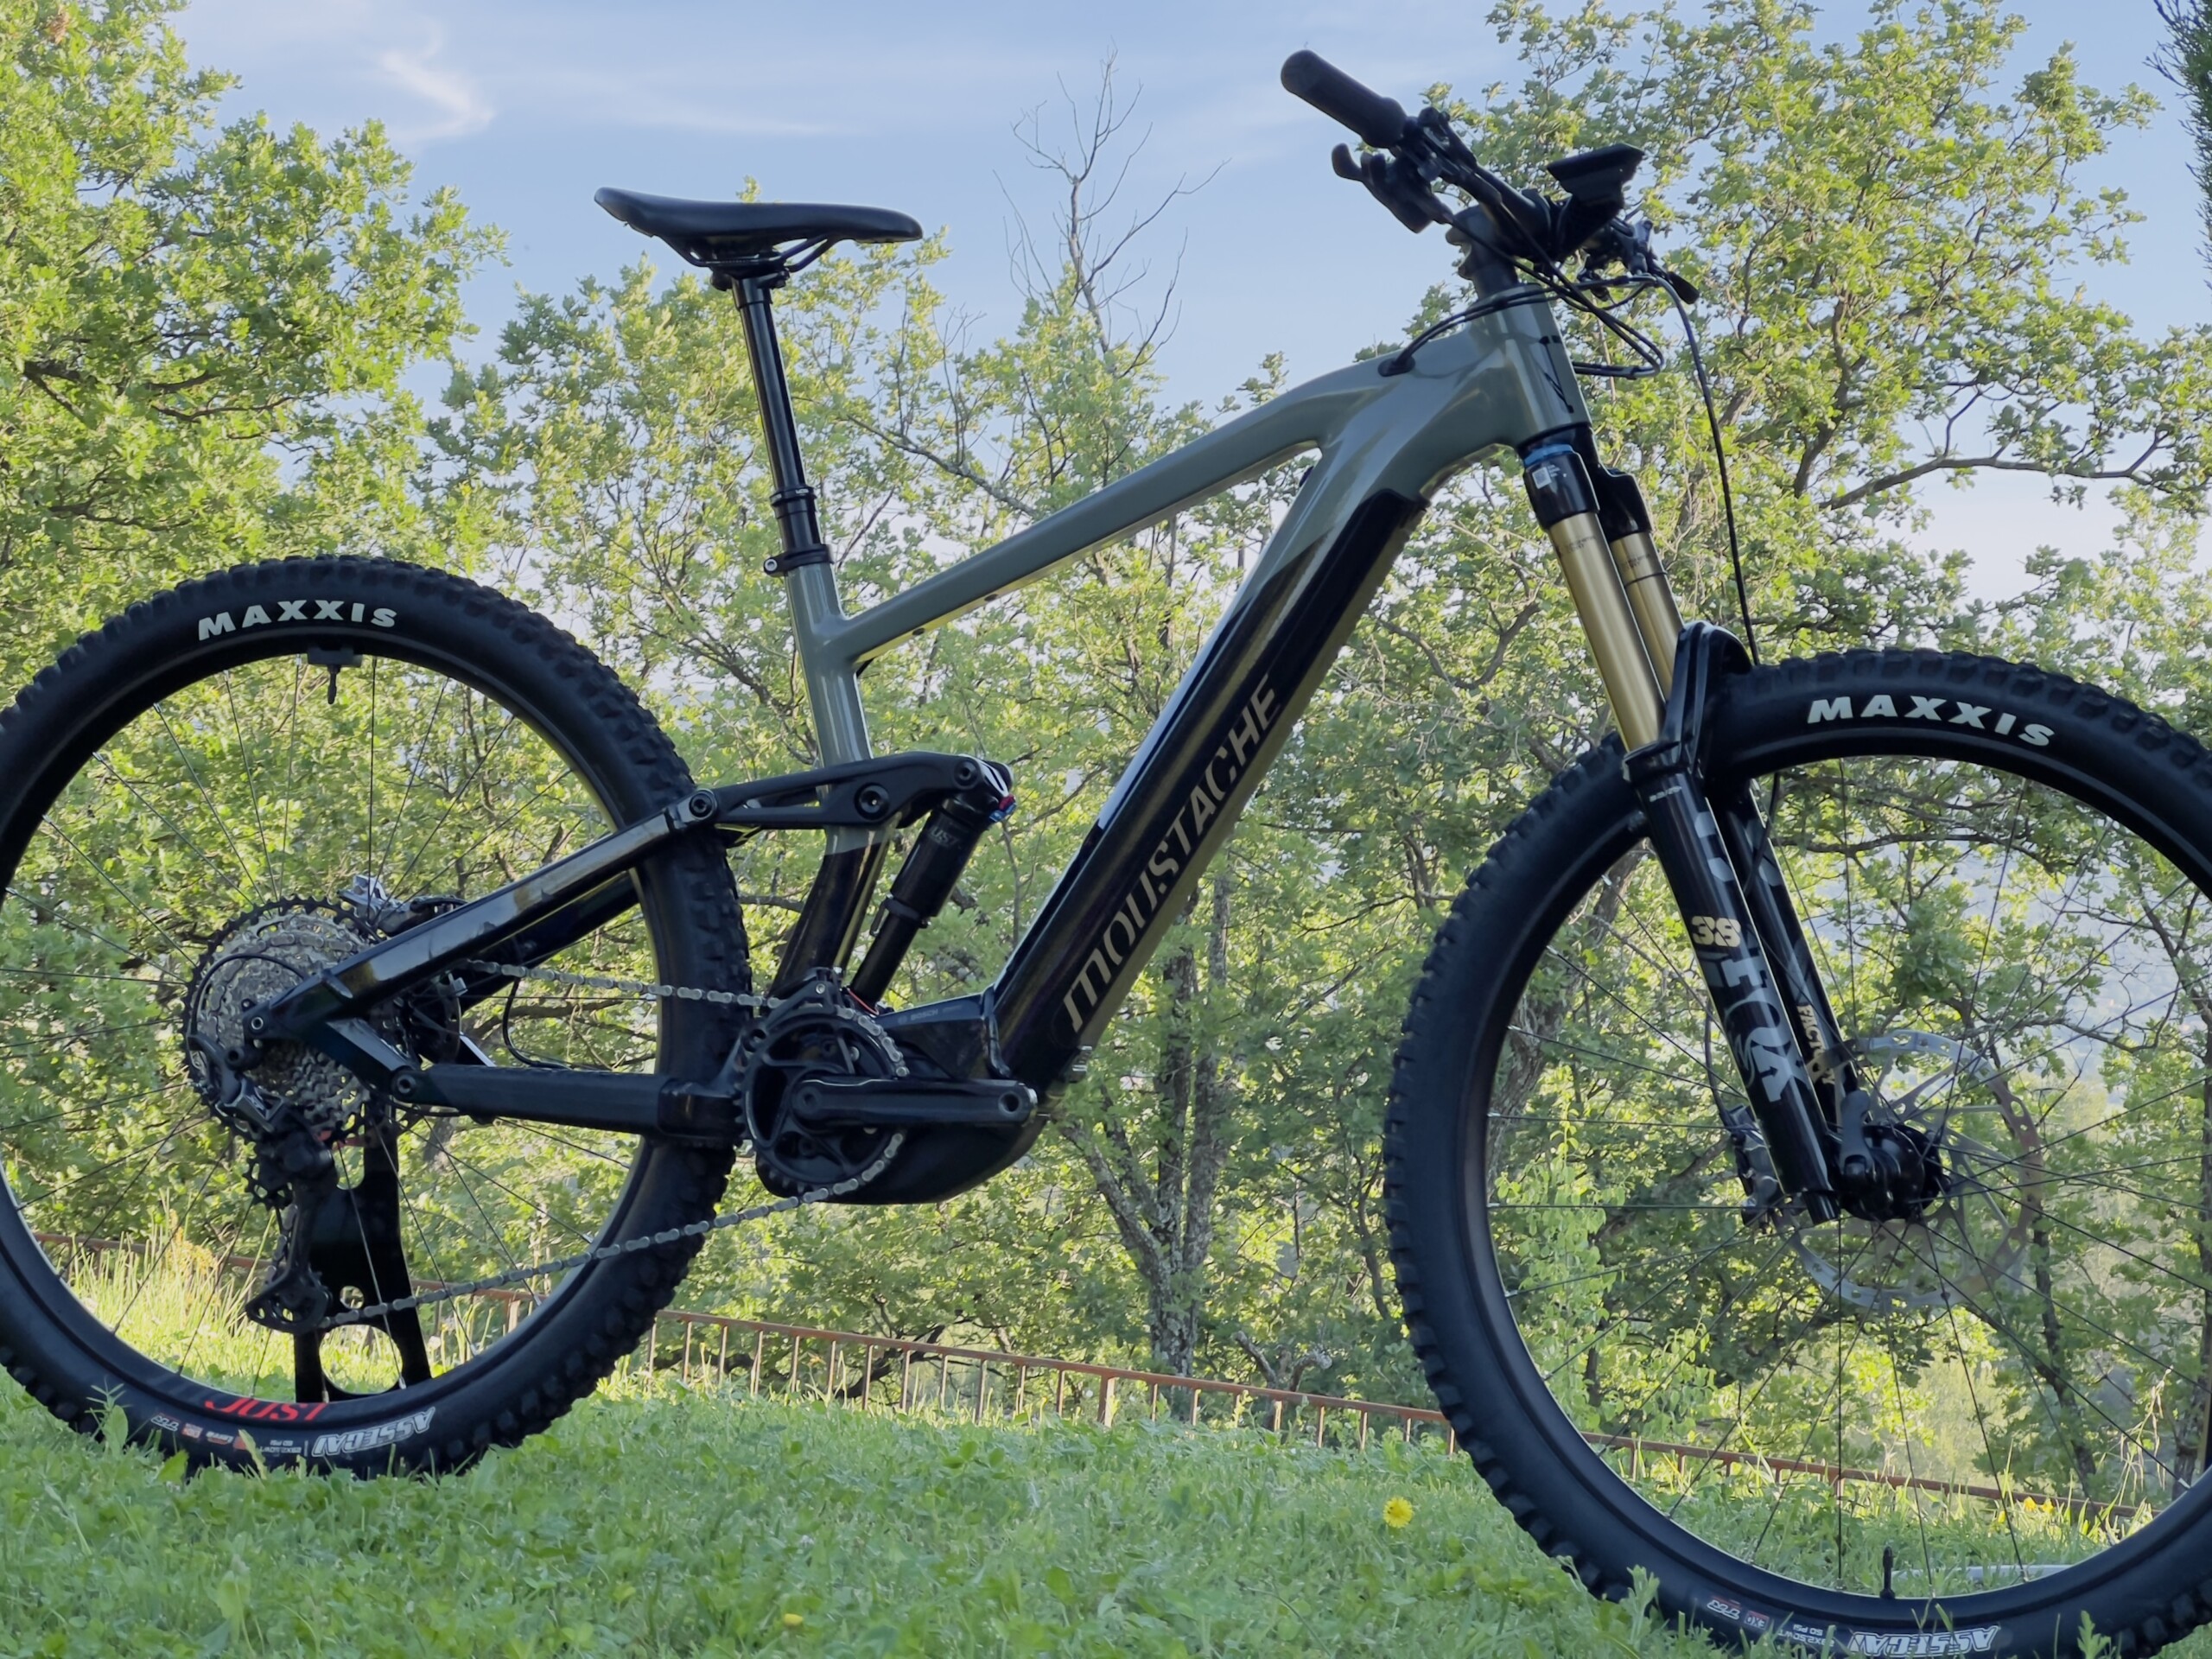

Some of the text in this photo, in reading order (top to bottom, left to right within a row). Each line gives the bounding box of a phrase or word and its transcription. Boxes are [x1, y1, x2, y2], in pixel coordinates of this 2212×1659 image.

[199, 600, 397, 641] MAXXIS
[1808, 694, 2056, 746] MAXXIS
[1063, 673, 1281, 1033] MOUSTACHE
[1691, 916, 1741, 947] 38
[1721, 954, 1812, 1103] FOX
[312, 1407, 435, 1457] ASSEGAI
[1793, 1624, 1808, 1634] PSI
[1847, 1625, 2000, 1658] ASSEGAI
